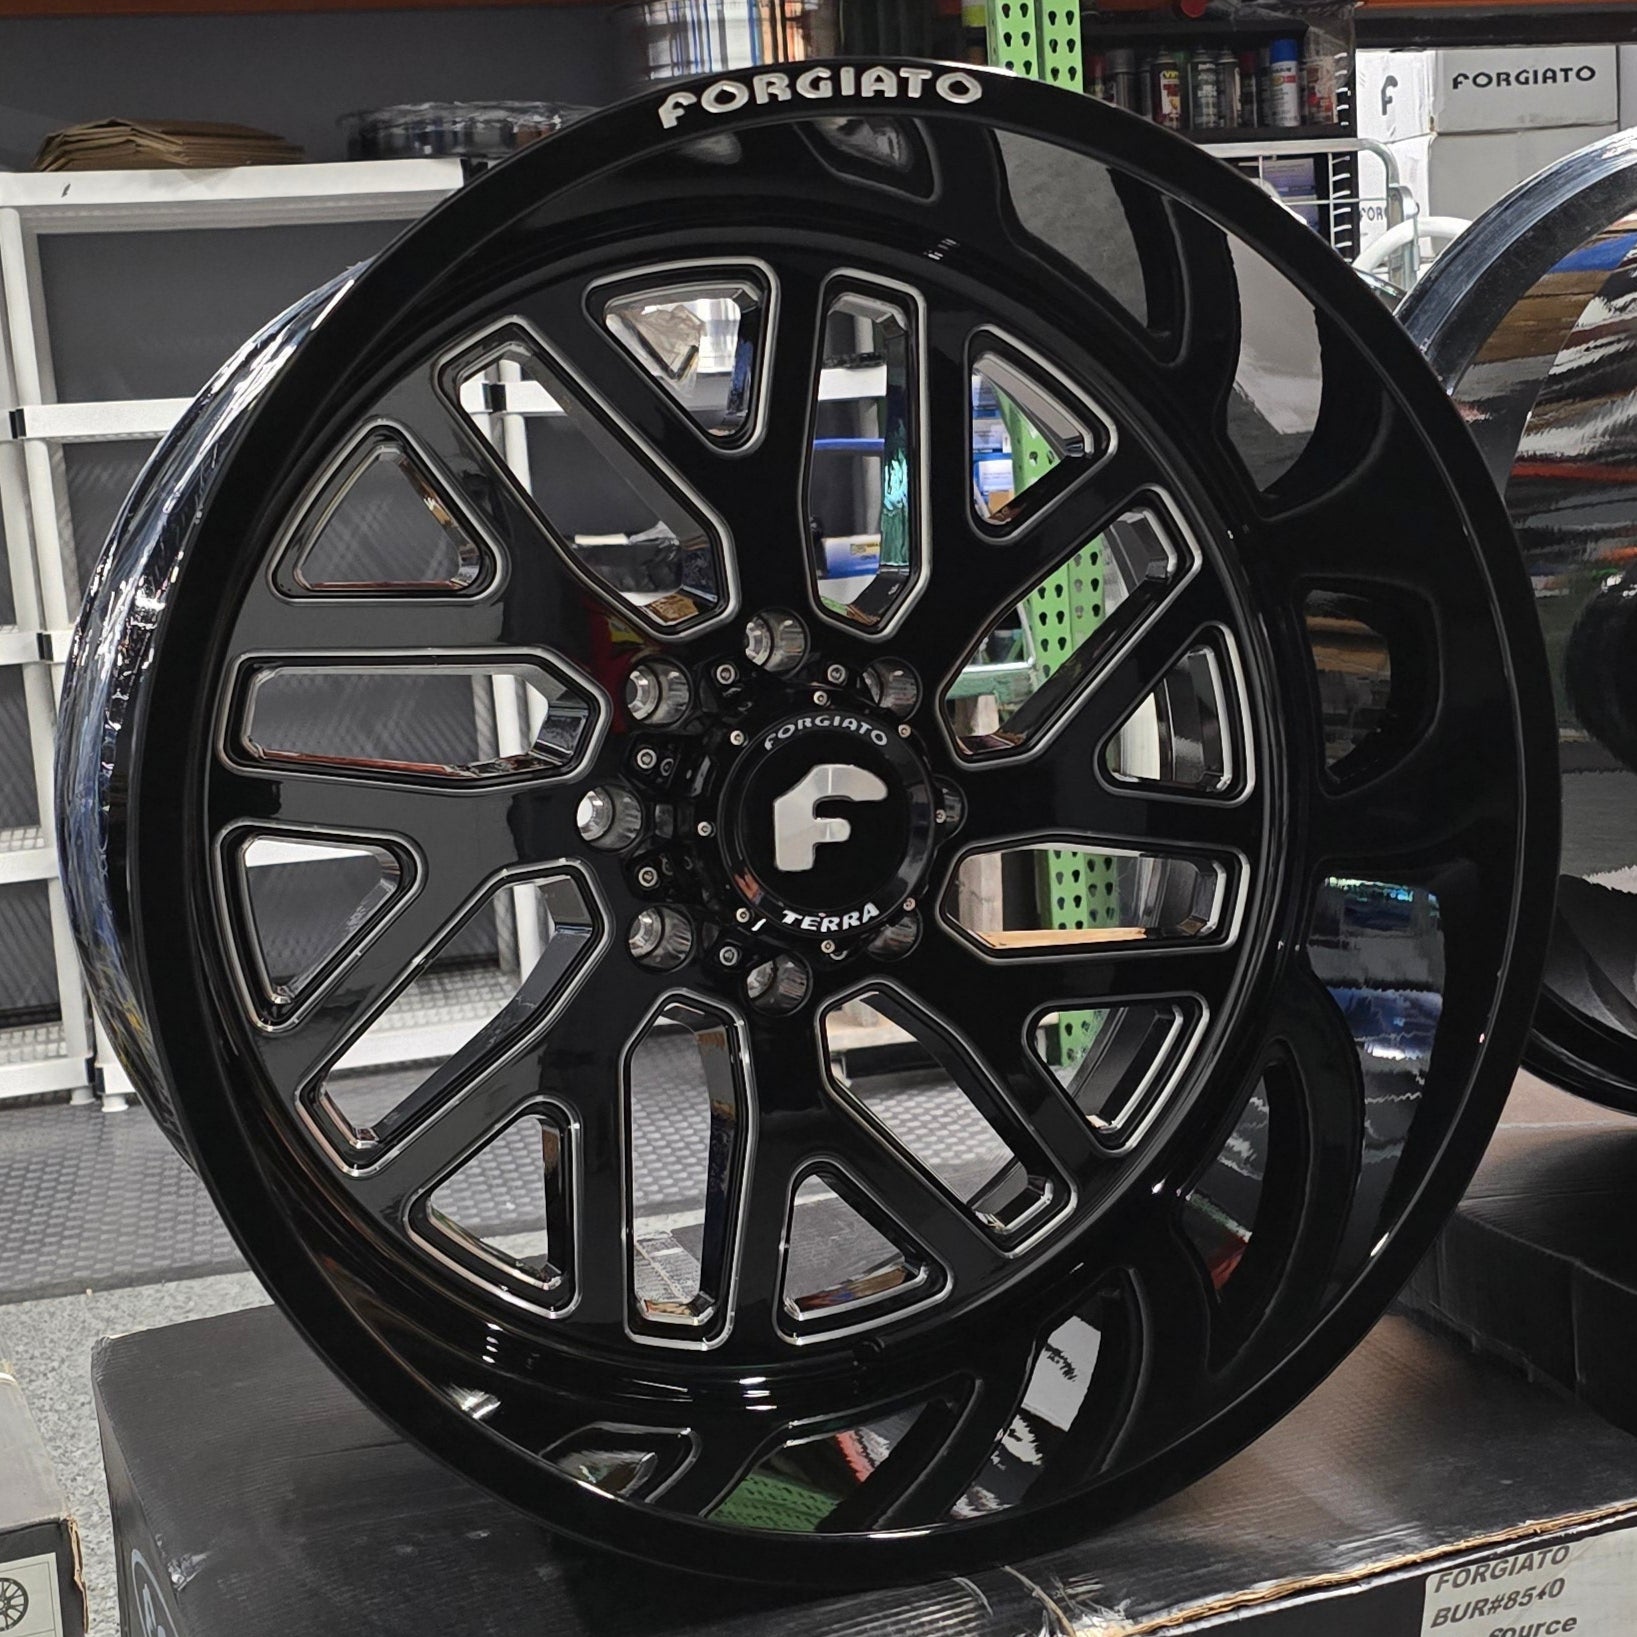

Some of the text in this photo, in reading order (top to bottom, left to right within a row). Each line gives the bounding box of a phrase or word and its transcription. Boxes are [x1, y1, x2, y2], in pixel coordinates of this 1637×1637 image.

[658, 66, 982, 129] FORGIATO
[1452, 65, 1596, 89] FORGIATO
[764, 715, 888, 751] FORGIATO
[774, 763, 888, 872] F
[782, 902, 880, 933] TERRA
[1434, 1545, 1571, 1593] FORGIATO
